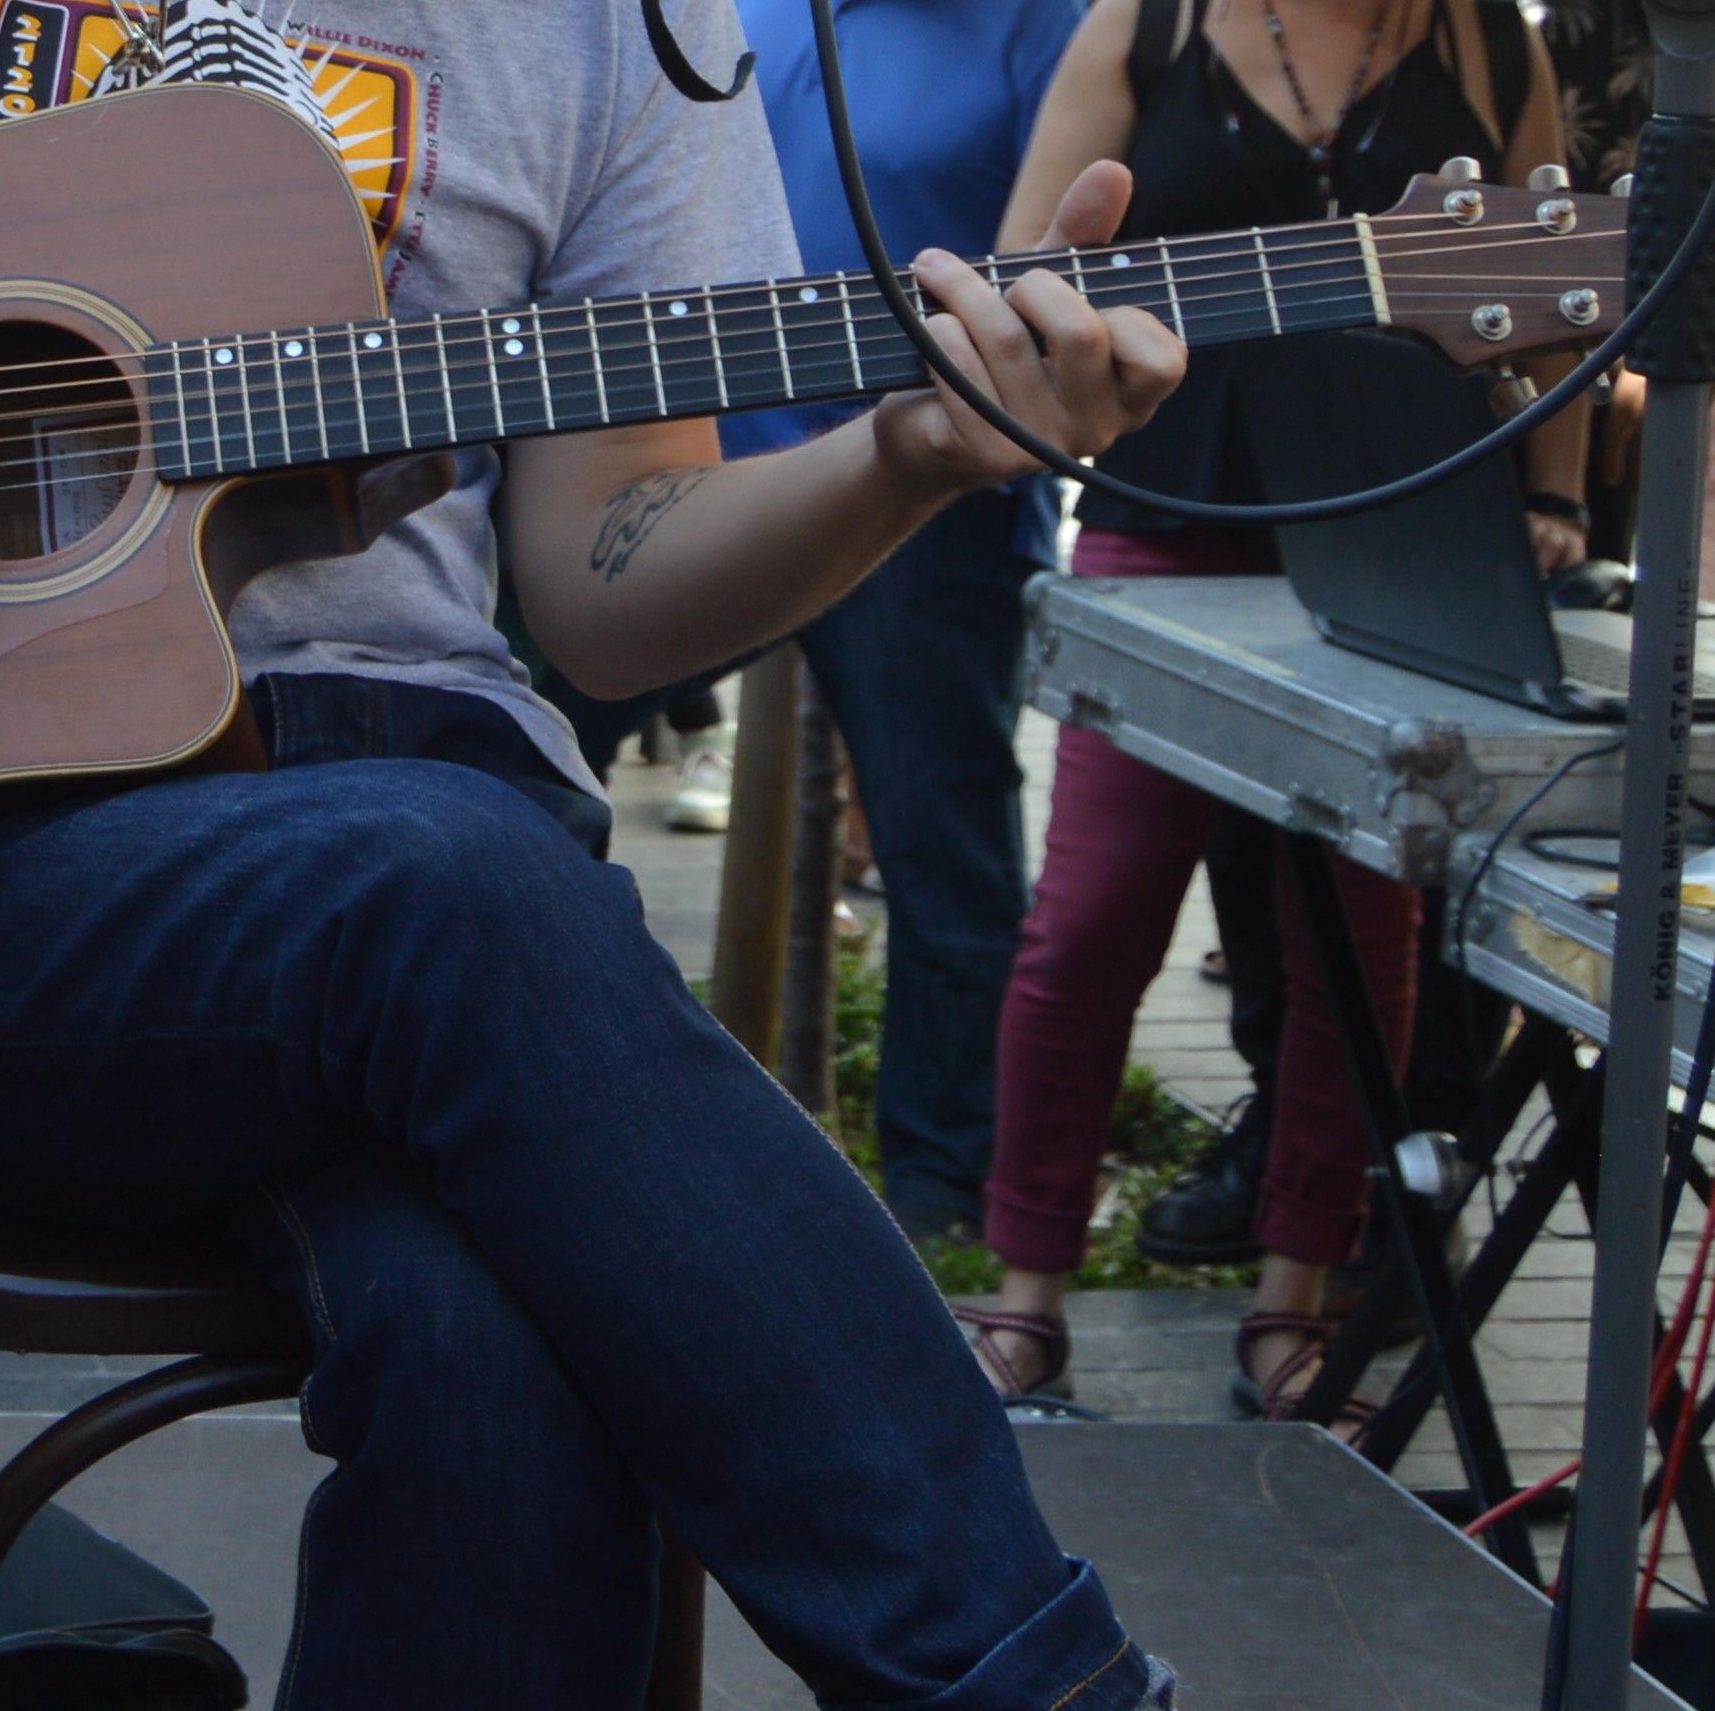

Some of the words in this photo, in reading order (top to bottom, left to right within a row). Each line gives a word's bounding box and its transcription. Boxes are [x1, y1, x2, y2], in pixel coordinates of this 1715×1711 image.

[425, 72, 444, 133] CHUCK
[422, 138, 440, 197] BERRY
[1662, 773, 1683, 870] MEYER
[1650, 910, 1676, 1001] KÖNIG
